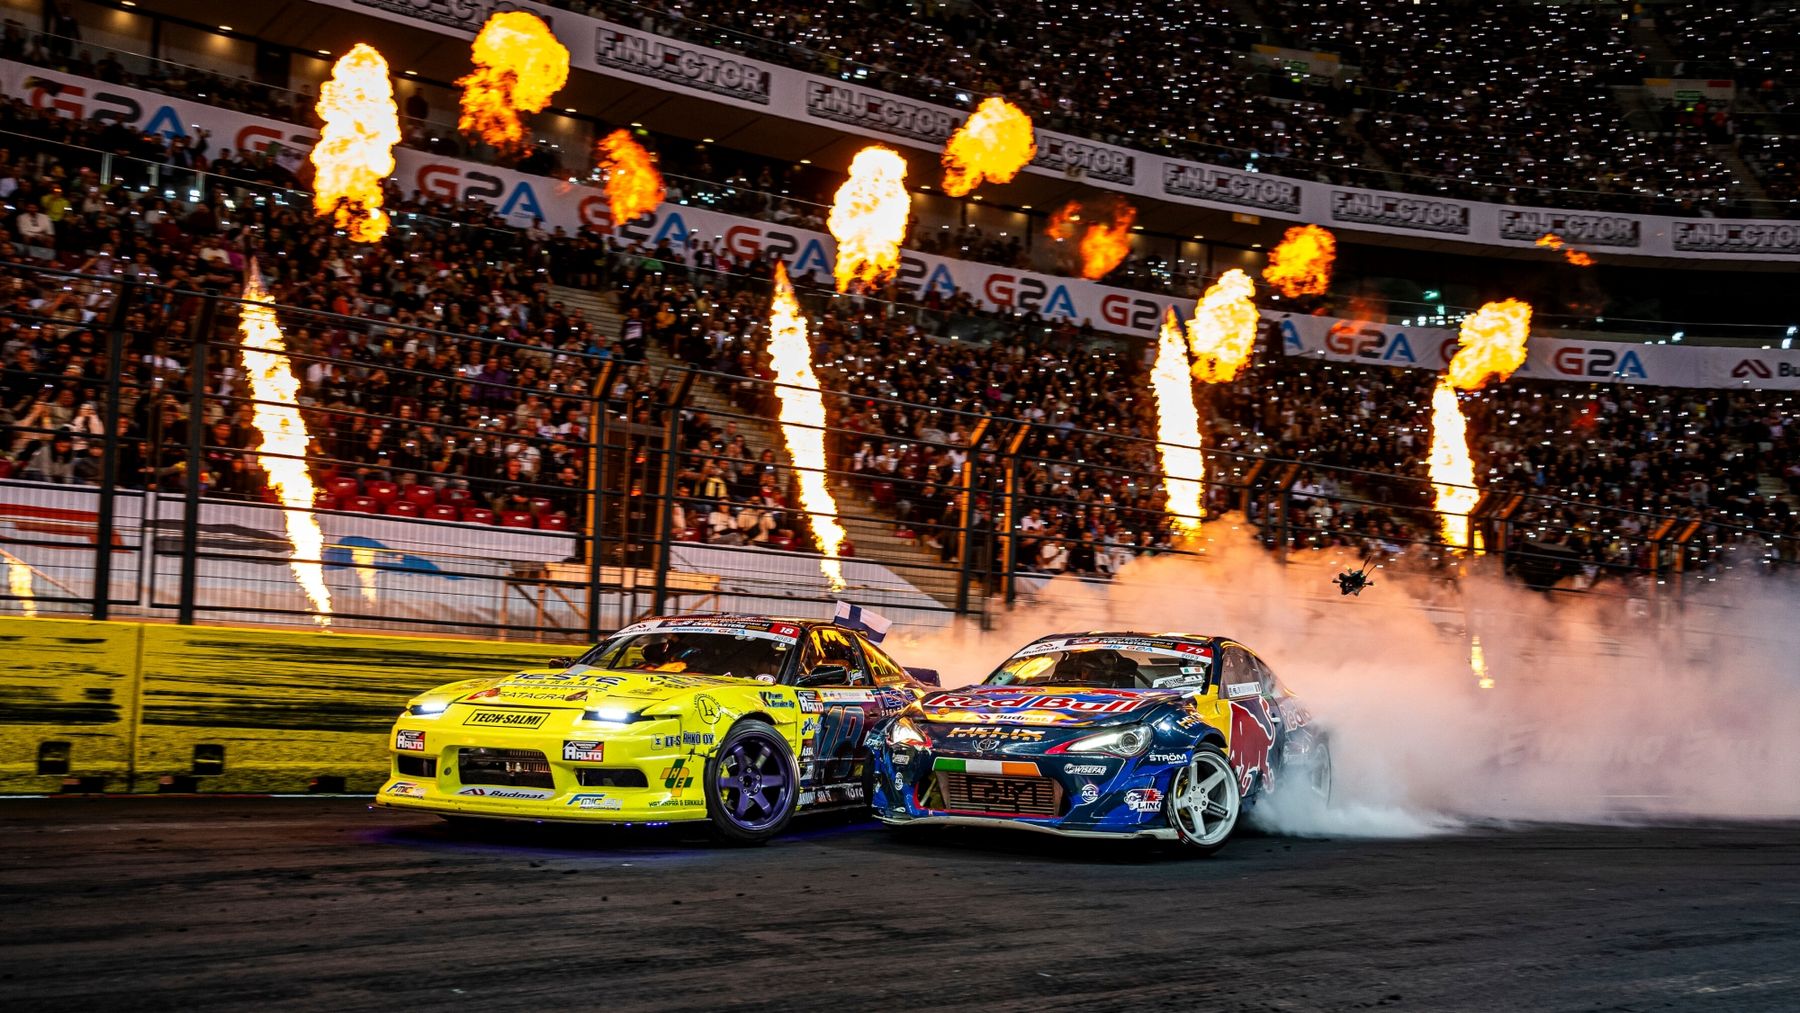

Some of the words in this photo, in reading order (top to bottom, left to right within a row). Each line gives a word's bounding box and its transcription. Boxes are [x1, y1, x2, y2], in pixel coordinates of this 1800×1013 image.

[417, 164, 546, 222] G2A
[1673, 222, 1800, 248] FINJECTO
[726, 225, 831, 274] G2A
[984, 273, 1077, 317] G2A
[1325, 319, 1415, 361] G2A
[1555, 347, 1648, 377] G2A
[780, 626, 795, 635] 18
[1186, 646, 1205, 654] 79
[926, 694, 1036, 708] Red
[1033, 696, 1143, 713] Bull
[472, 712, 542, 726] TECH-SALMI
[1149, 752, 1187, 762] STRÖM
